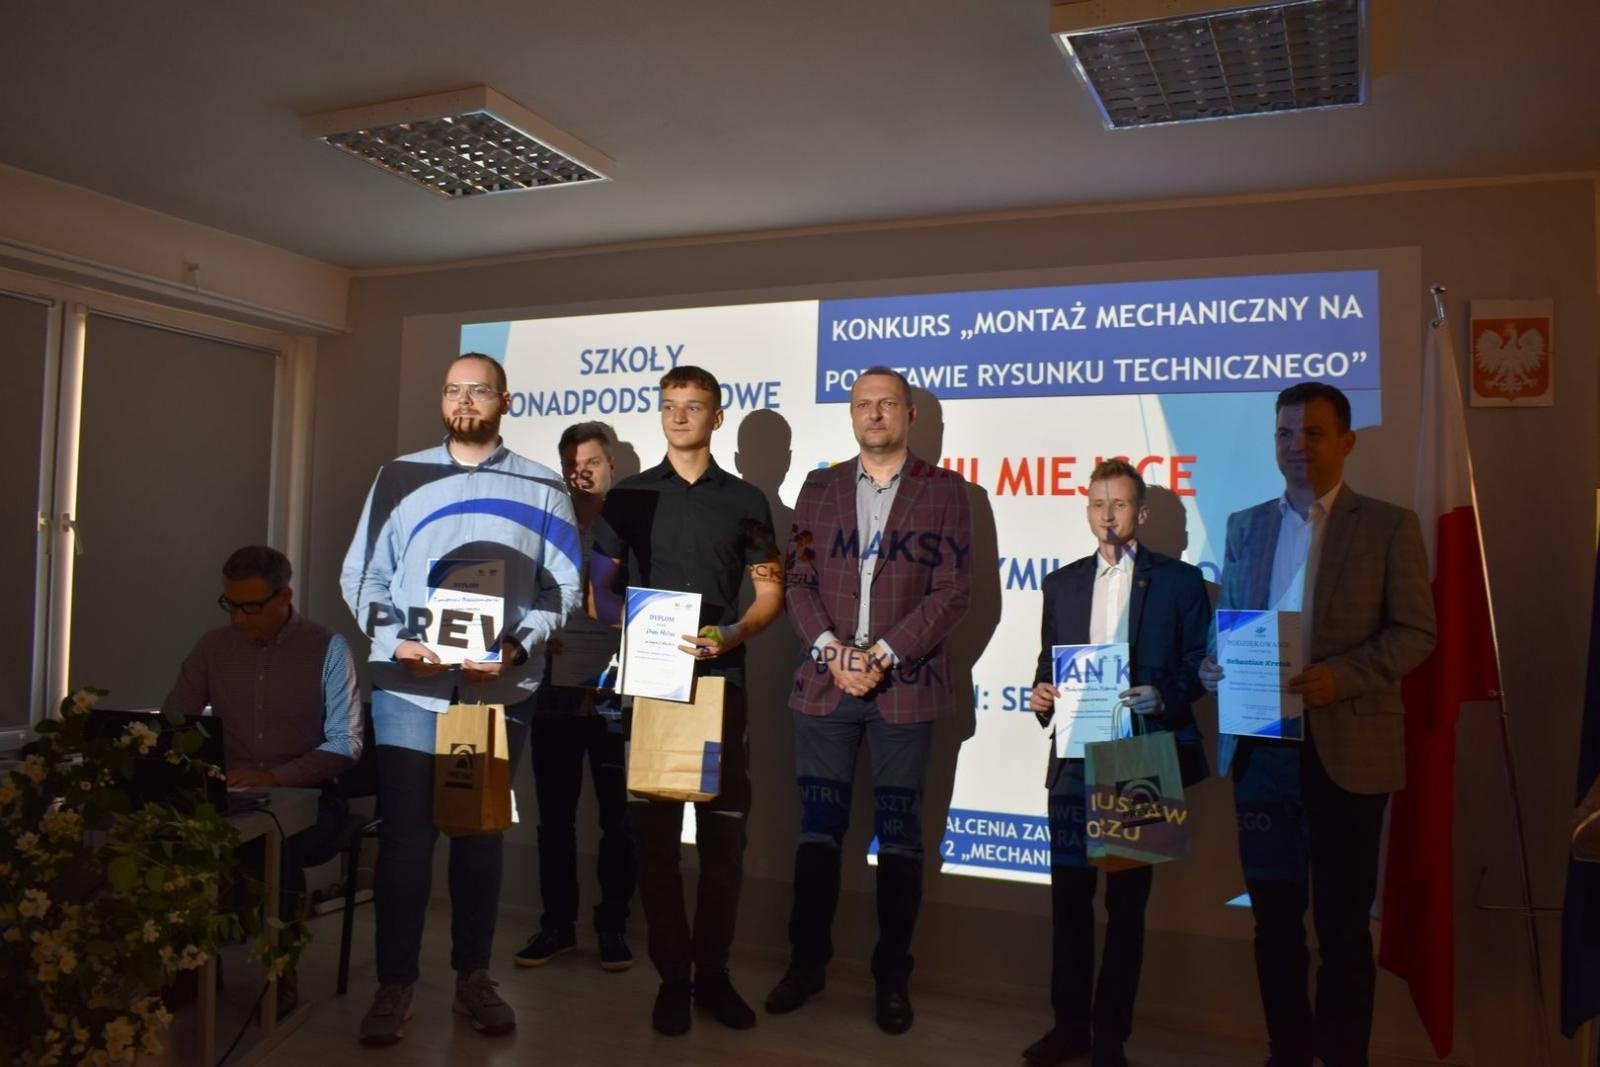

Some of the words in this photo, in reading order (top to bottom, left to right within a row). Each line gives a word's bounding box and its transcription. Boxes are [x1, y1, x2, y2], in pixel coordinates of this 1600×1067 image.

[831, 314, 951, 342] KONKURS
[960, 300, 1087, 340] „MONTAŻ
[1095, 297, 1310, 330] MECHANICZNY
[1319, 294, 1364, 321] NA
[579, 344, 685, 376] SZKOŁY
[977, 359, 1105, 388] RYSUNKU
[1113, 350, 1368, 383] TECHNICZNEGO”
[945, 840, 955, 856] 2
